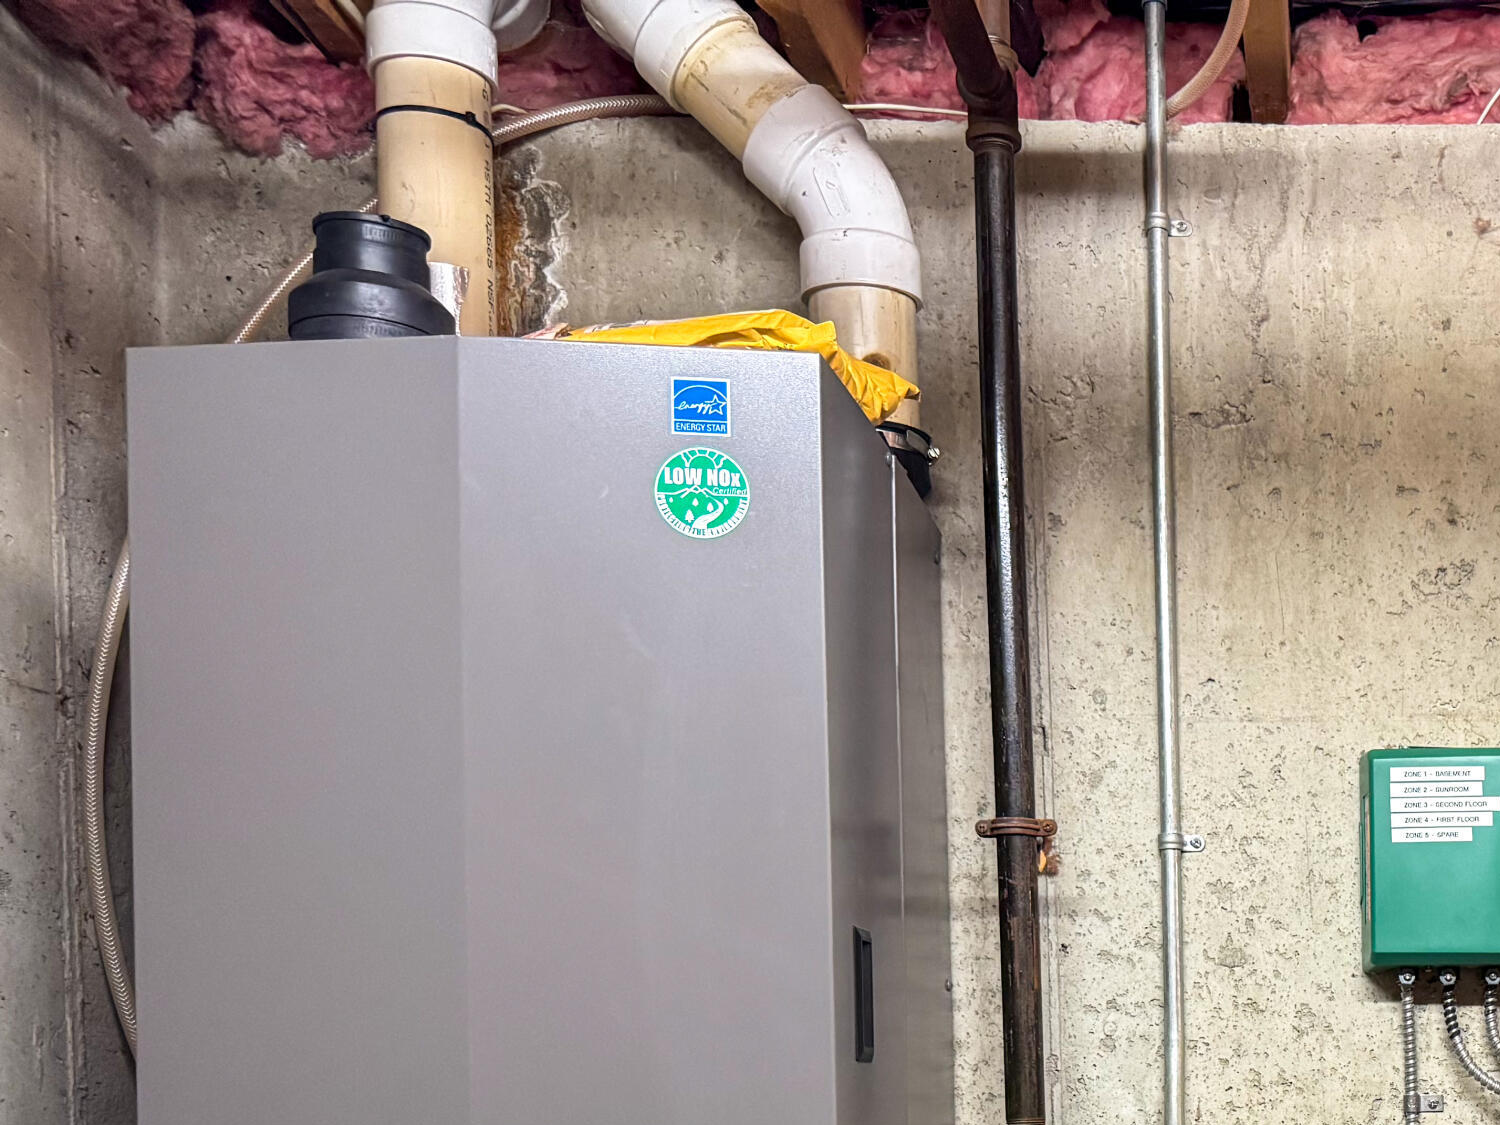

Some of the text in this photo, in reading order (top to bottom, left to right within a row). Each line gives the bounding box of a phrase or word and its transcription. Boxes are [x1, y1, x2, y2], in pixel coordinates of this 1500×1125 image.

[676, 422, 726, 432] ENERGY STAR
[664, 467, 741, 487] LOW NOx
[712, 487, 748, 496] Certified
